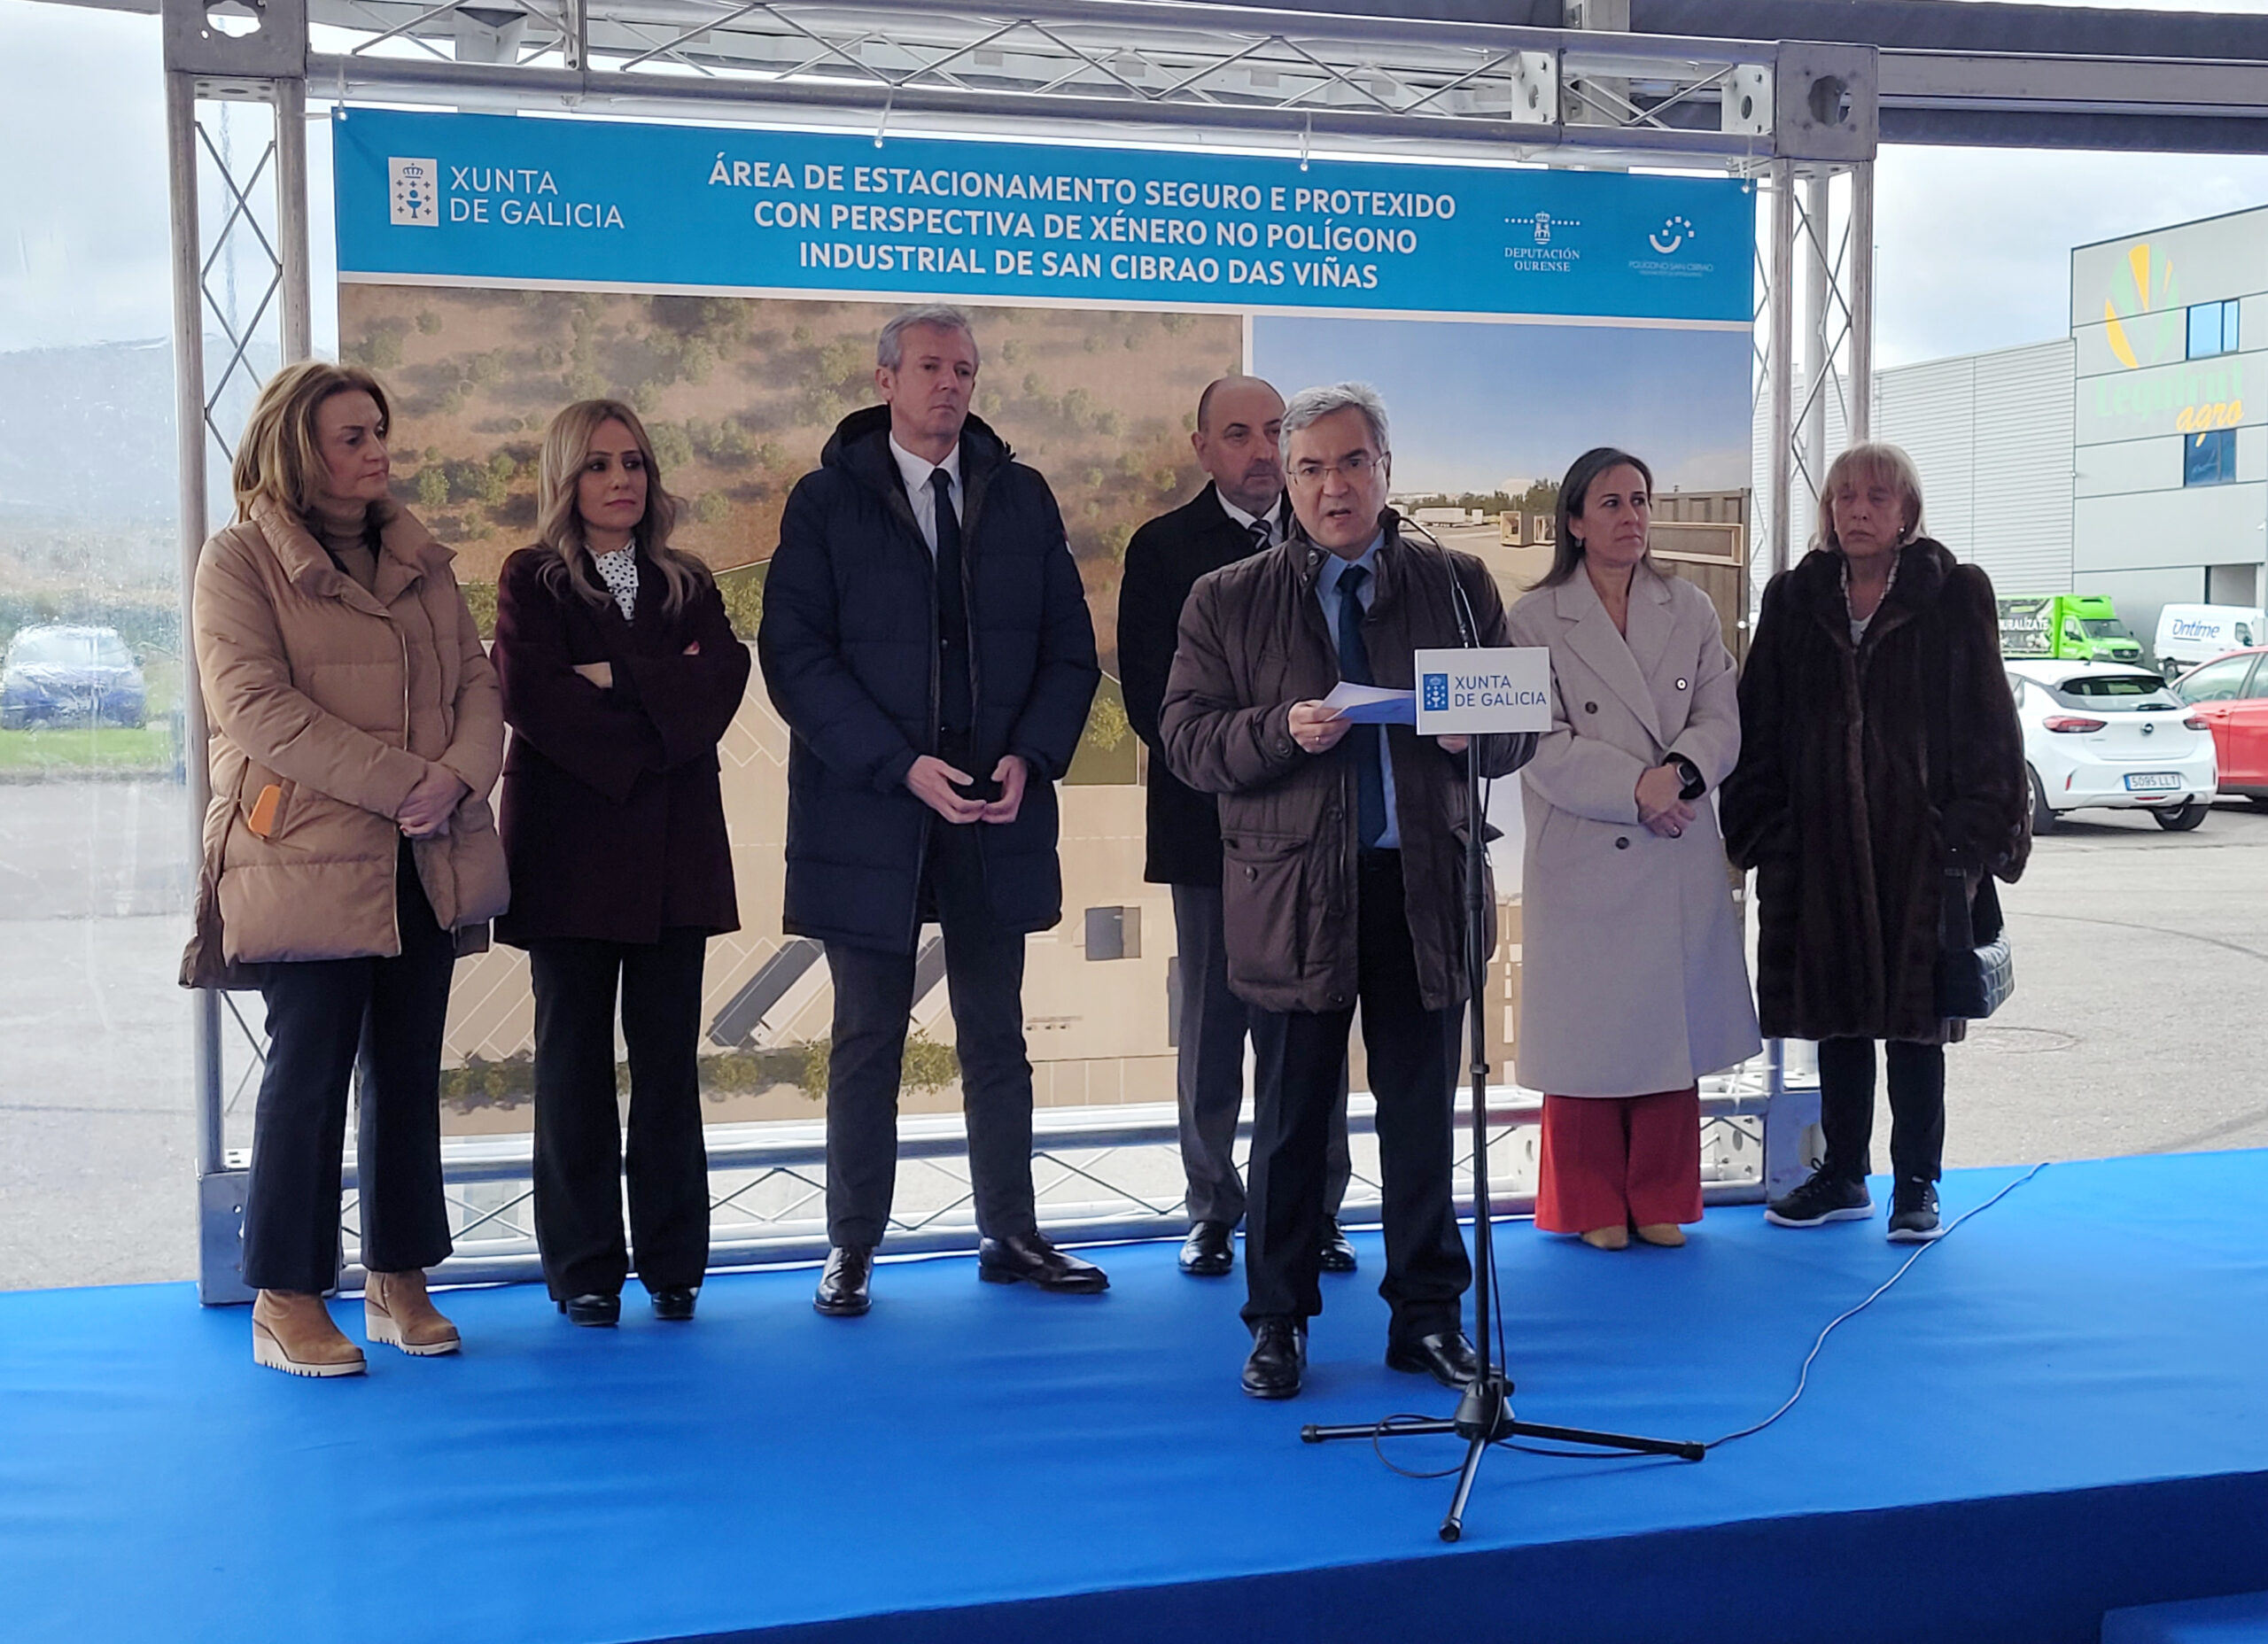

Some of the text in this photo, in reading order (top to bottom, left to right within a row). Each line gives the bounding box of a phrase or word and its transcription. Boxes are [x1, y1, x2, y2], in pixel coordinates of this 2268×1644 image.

[450, 166, 558, 195] XUNTA
[709, 151, 1456, 219] ÁREA DE ESTACIONAMENTO SEGURO E PROTEXIDO
[450, 198, 625, 229] DE GALICIA
[754, 201, 1418, 254] CON PERSPECTIVA DE XÉNERO NO POLÍGONO
[800, 242, 1379, 289] INDUSTRIAL DE SAN CIBRAO DAS VIÑAS
[1504, 247, 1580, 260] DEPUTACIÓN
[1514, 260, 1571, 272] OURENSE
[2176, 399, 2245, 448] agro
[2172, 618, 2220, 639] Ontime
[1455, 675, 1512, 690] XUNTA
[1455, 691, 1547, 708] DE GALICIA
